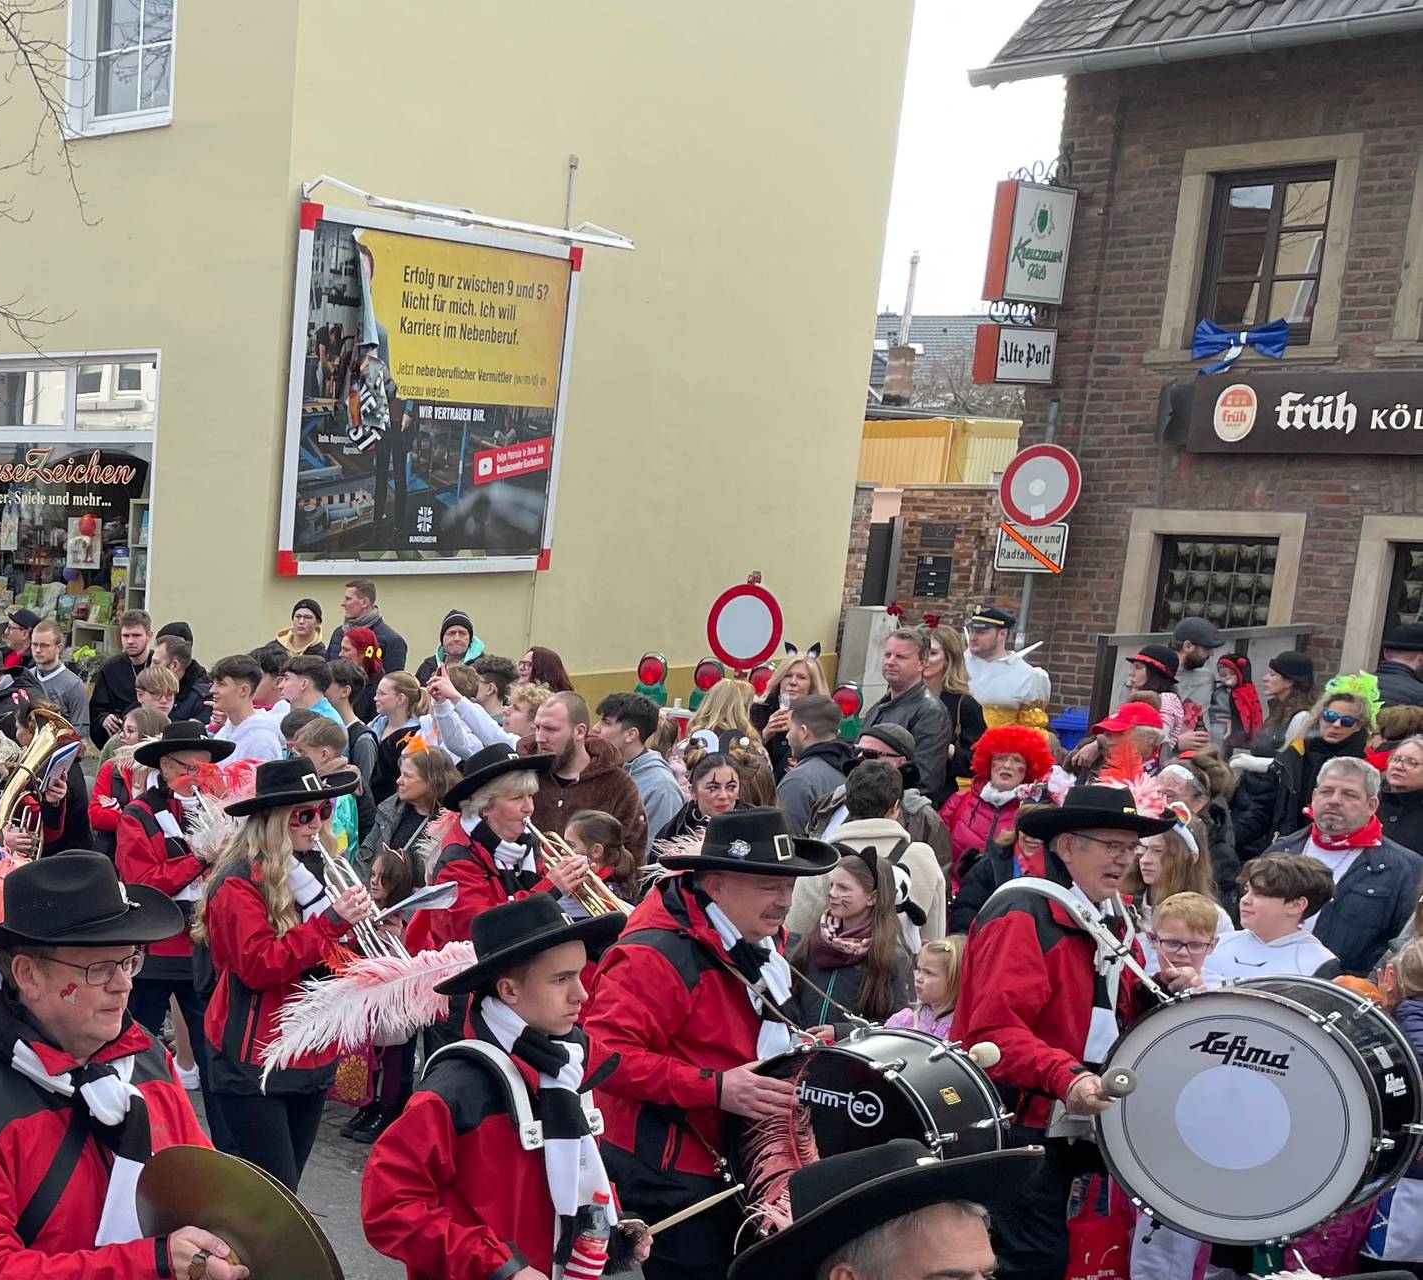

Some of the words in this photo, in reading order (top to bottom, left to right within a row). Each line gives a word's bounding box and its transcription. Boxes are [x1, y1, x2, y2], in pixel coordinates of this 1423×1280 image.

[1012, 236, 1063, 268] Kreuzauer
[403, 265, 434, 290] Erfolg
[438, 273, 454, 289] nur
[457, 274, 504, 295] zwischen
[507, 279, 514, 295] 9
[516, 283, 534, 299] und
[537, 283, 549, 300] 5?
[1027, 263, 1047, 282] Pils
[401, 291, 430, 311] Nicht
[433, 294, 446, 312] für
[449, 300, 477, 316] mich.
[479, 301, 496, 319] Ich
[498, 304, 516, 321] will
[400, 316, 441, 337] Karriere
[443, 321, 456, 339] im
[459, 323, 519, 345] Nebenberuf.
[999, 339, 1024, 366] Alte
[396, 362, 415, 376] Jetzt
[478, 369, 513, 384] Vermittler
[419, 405, 433, 419] WIR
[434, 406, 472, 422] VERTRAUEN
[15, 490, 46, 508] Spiele
[49, 492, 70, 506] und
[72, 492, 112, 507] mehr...
[1044, 533, 1061, 544] und
[1232, 1061, 1287, 1077] PERCUSSION
